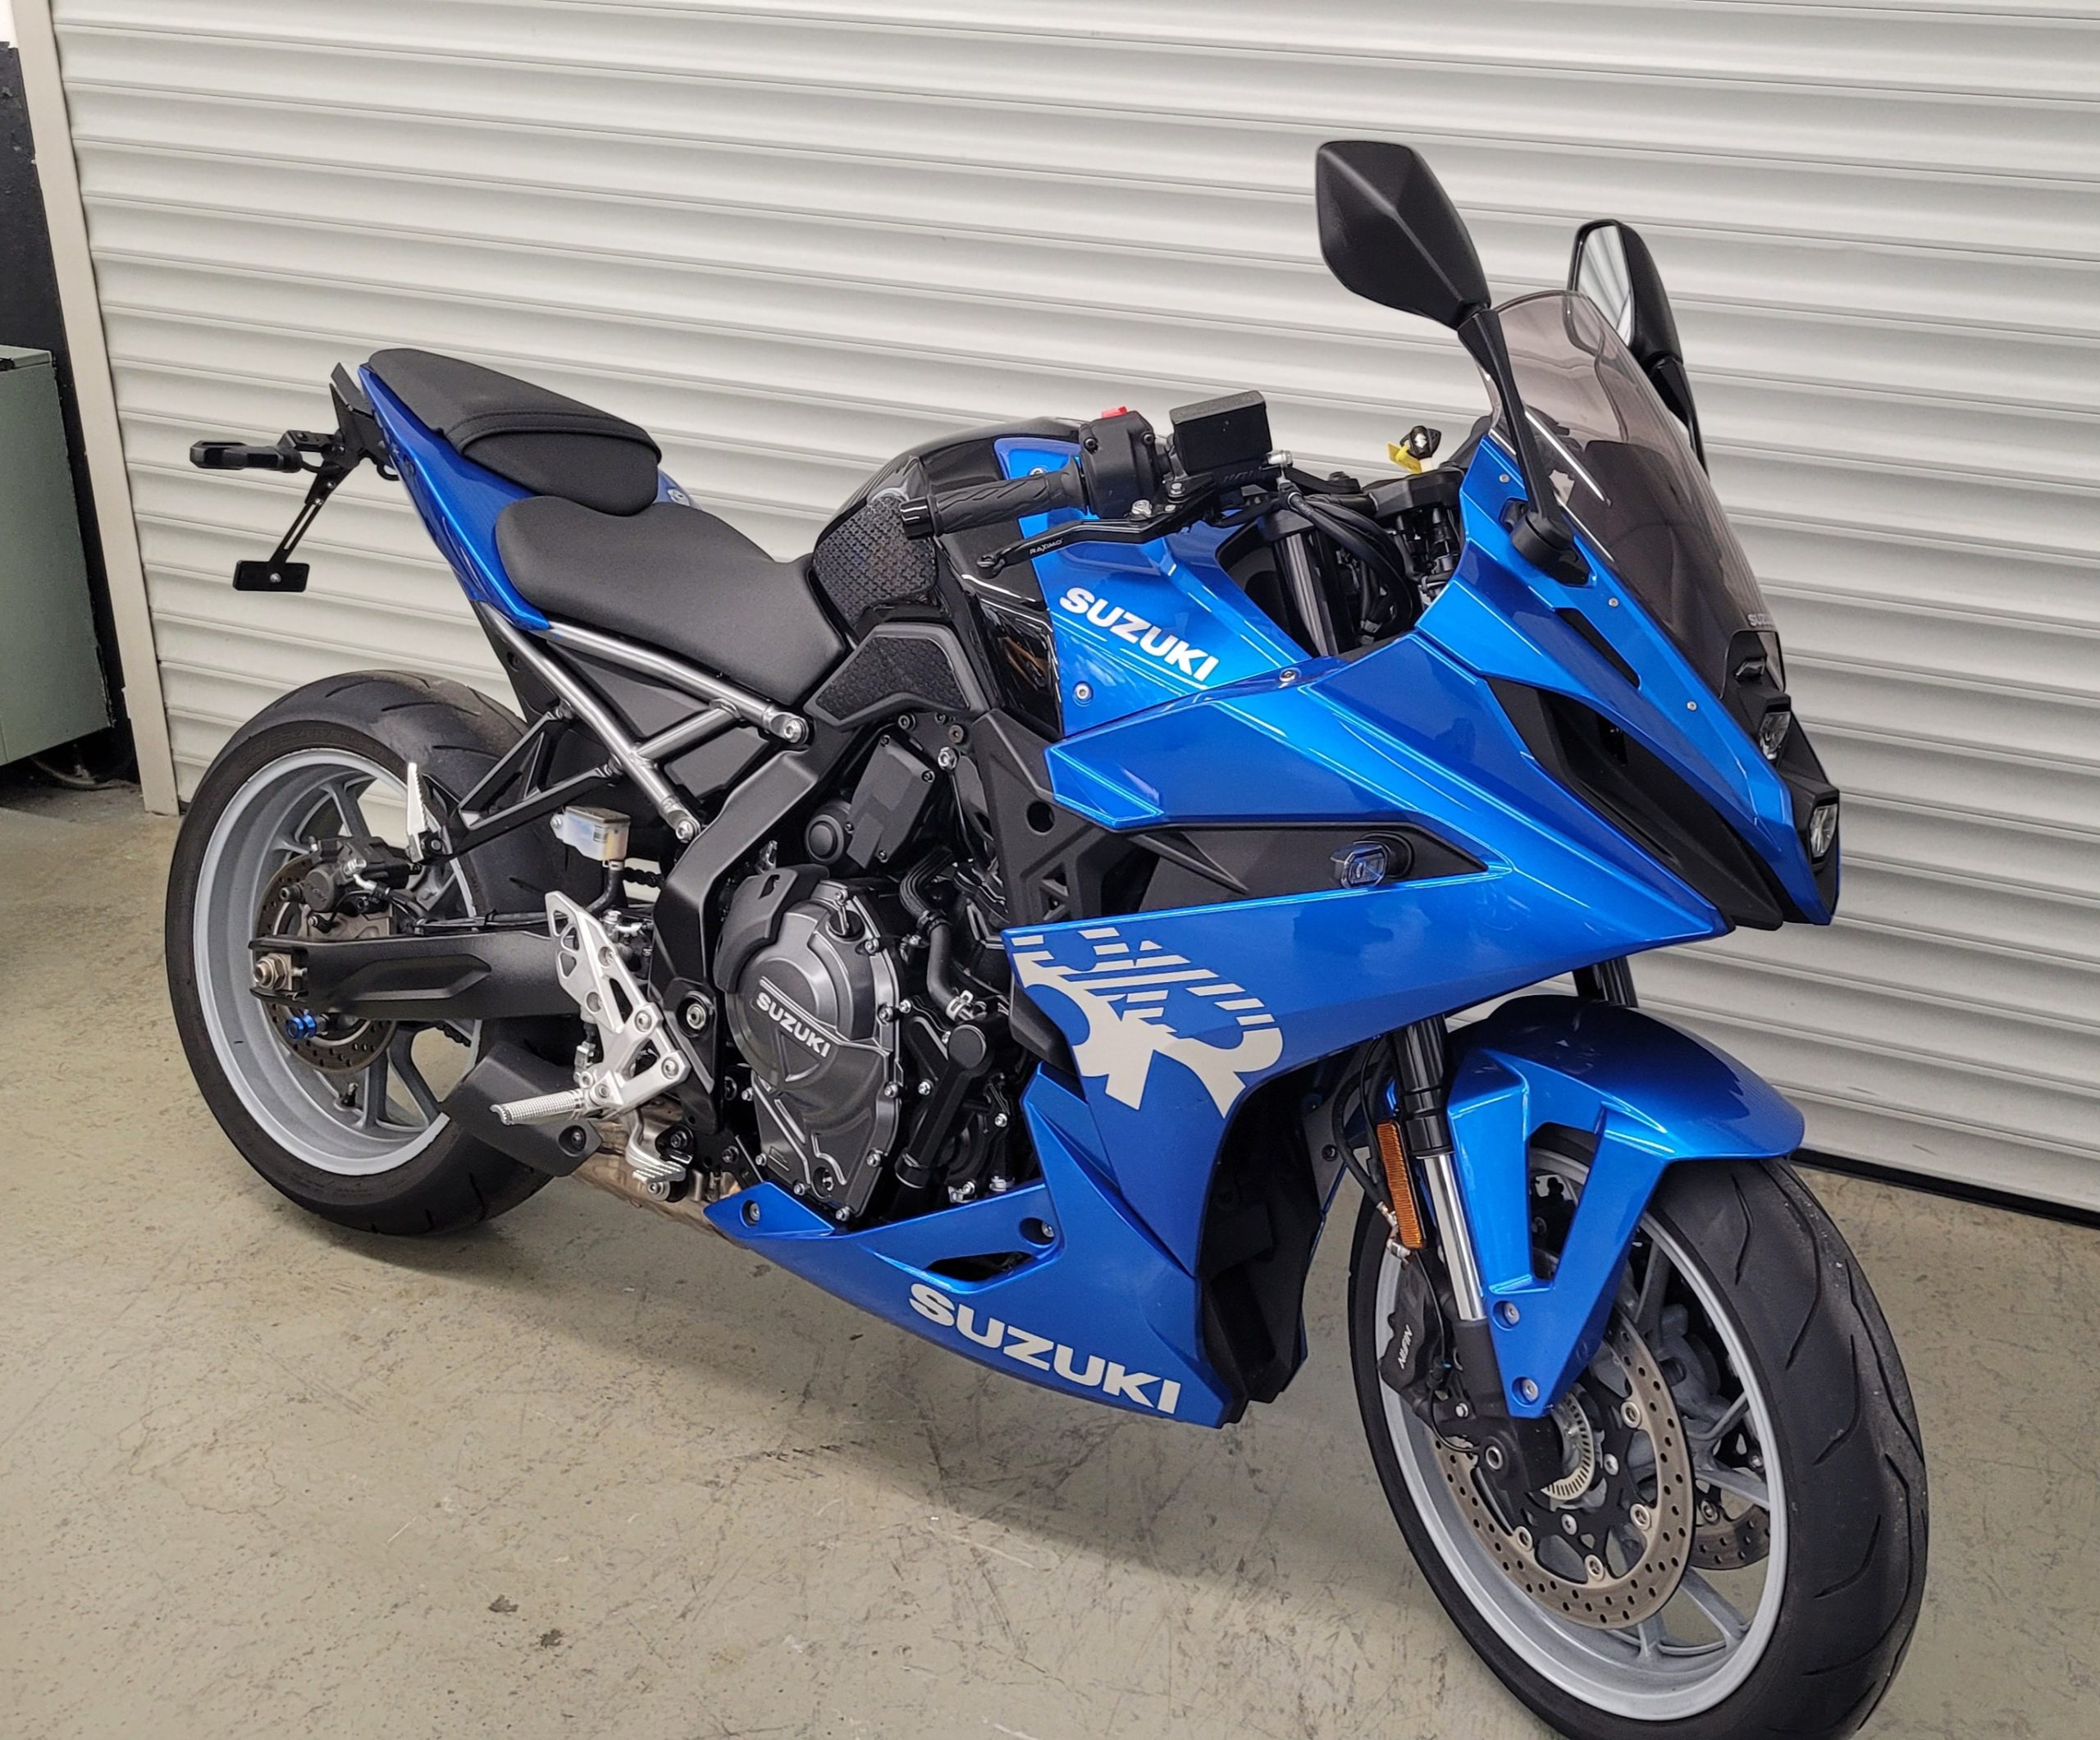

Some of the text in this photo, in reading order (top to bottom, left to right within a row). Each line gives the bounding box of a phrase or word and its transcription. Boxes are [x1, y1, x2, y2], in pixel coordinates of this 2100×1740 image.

[1029, 539, 1063, 555] RAXIMO
[1059, 587, 1220, 682] SUZUKI
[756, 992, 831, 1057] SUZUKI
[909, 1283, 1181, 1414] SUZUKI
